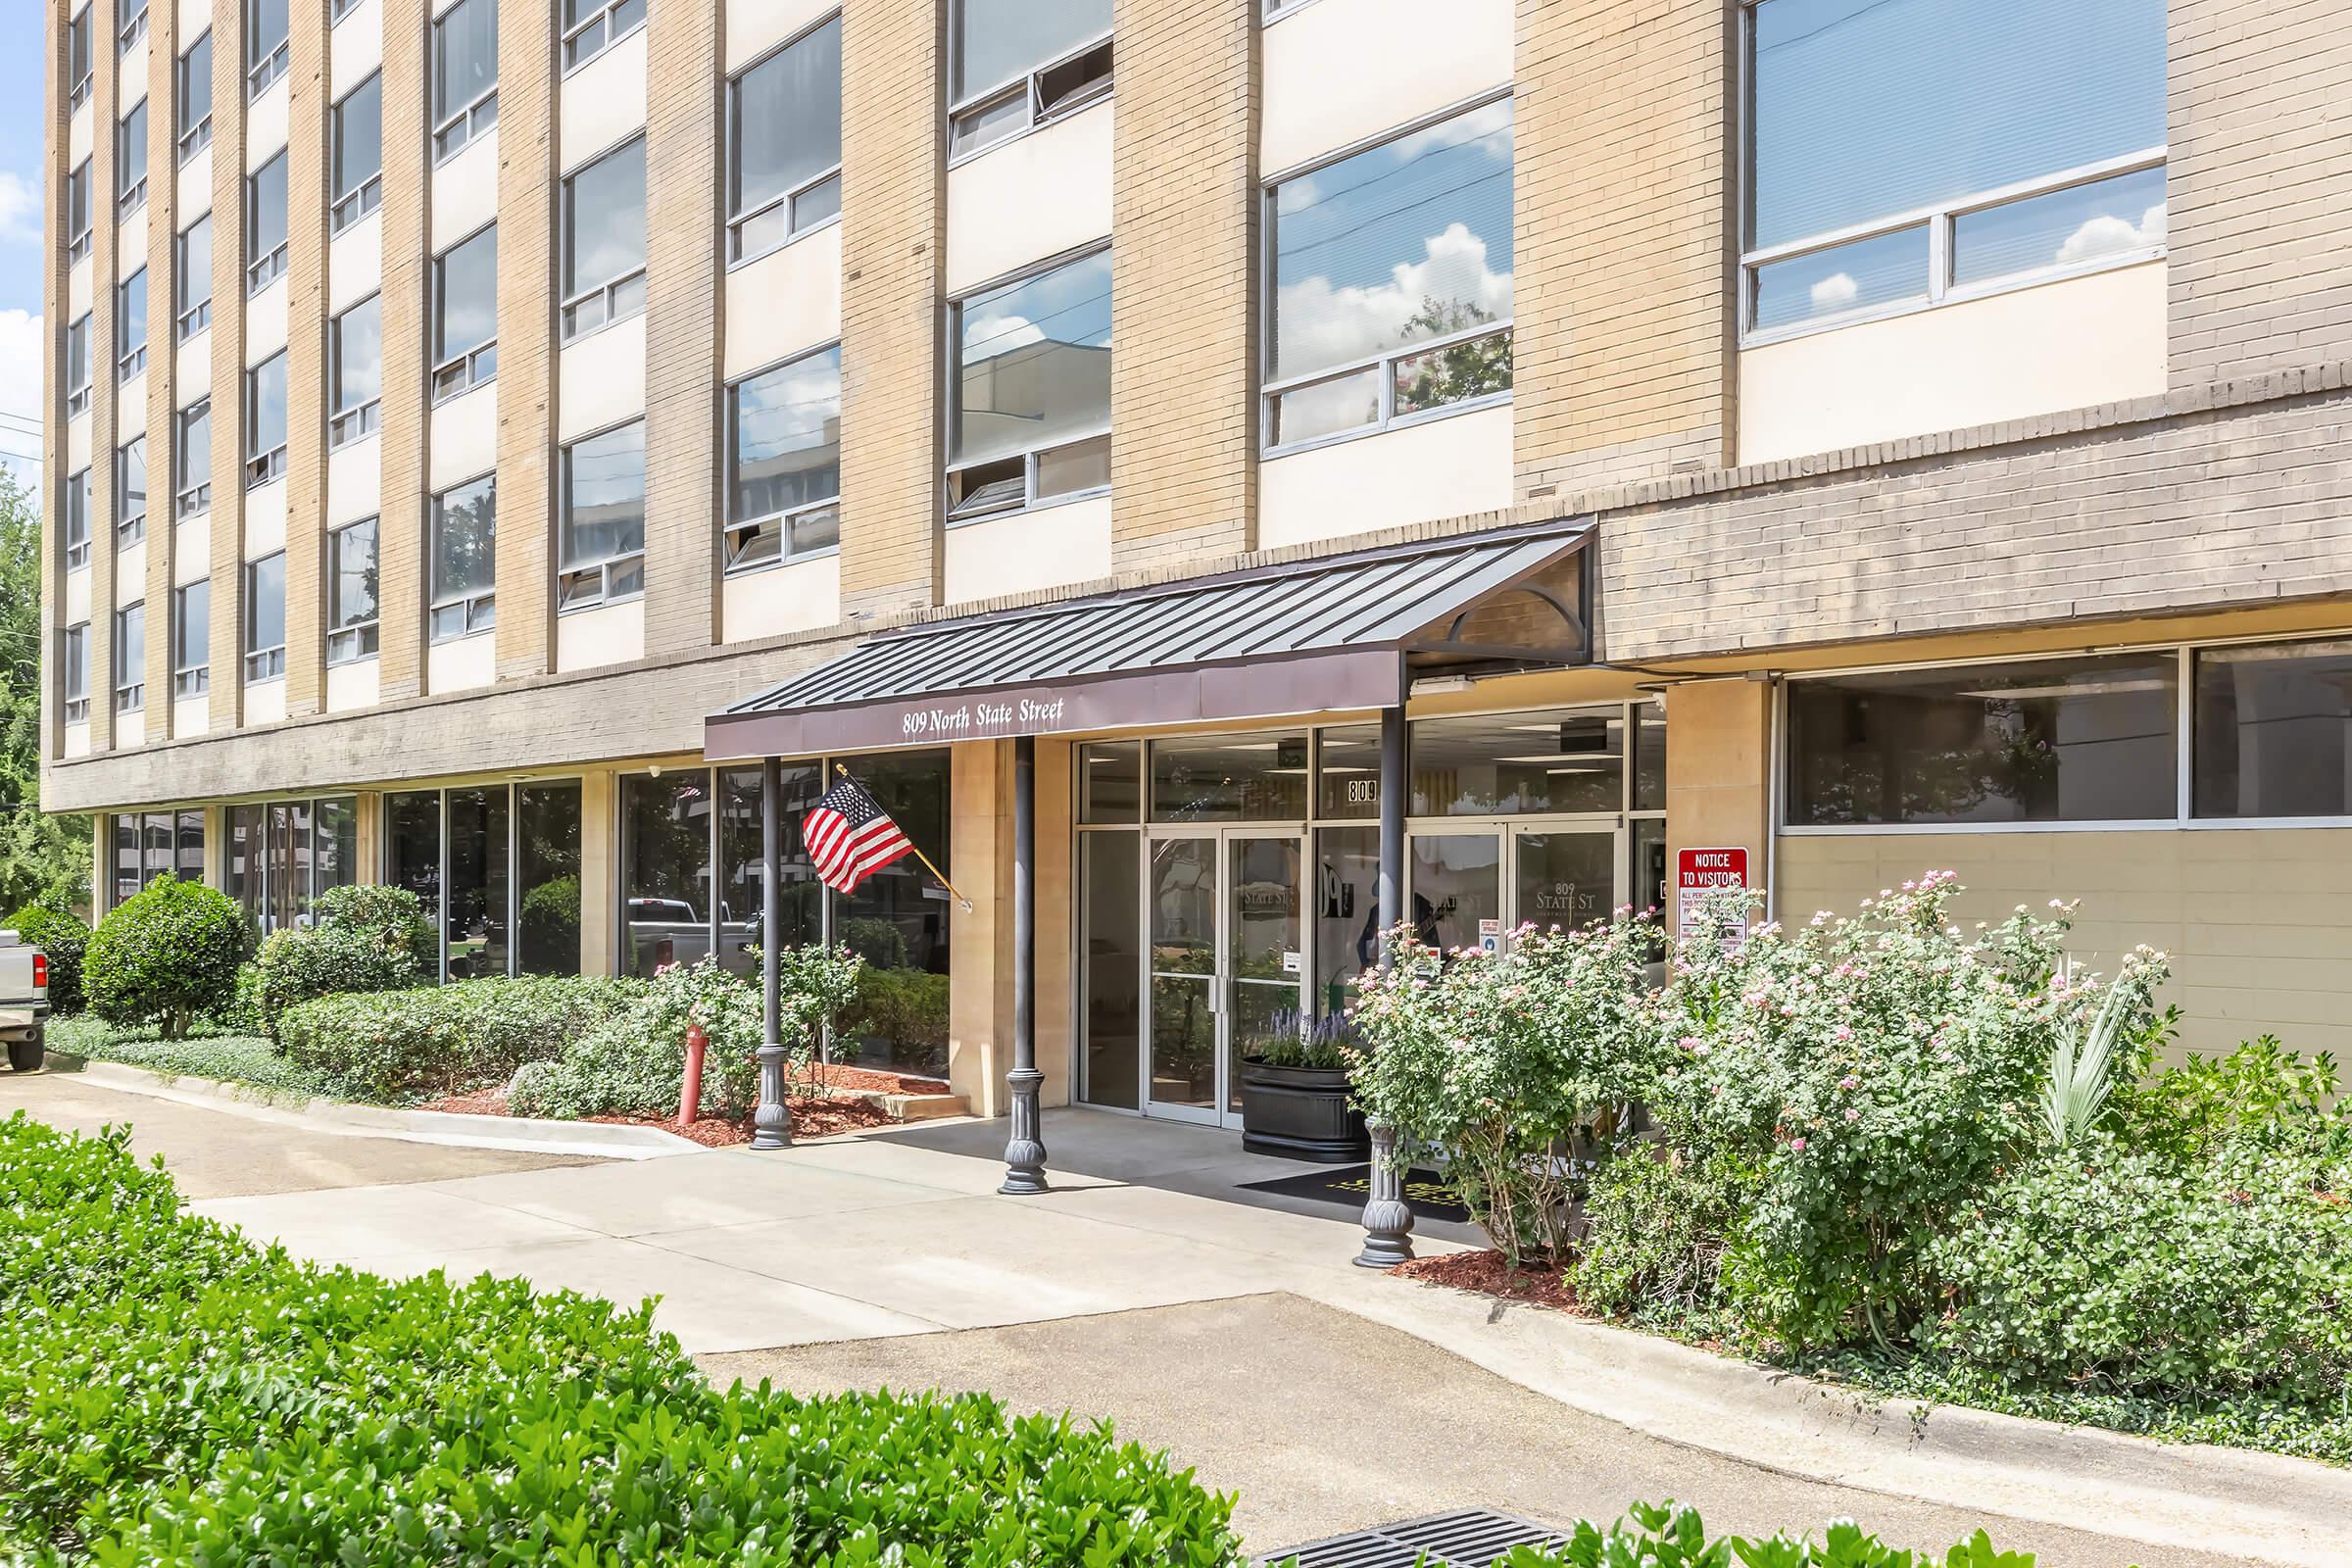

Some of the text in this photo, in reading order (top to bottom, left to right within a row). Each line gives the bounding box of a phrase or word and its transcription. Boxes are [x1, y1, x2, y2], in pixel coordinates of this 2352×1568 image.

[903, 698, 1064, 734] 809 North State Street
[1349, 781, 1376, 801] 809
[1694, 854, 1731, 867] NOTICE
[1683, 871, 1742, 886] TO VISITORS
[1555, 883, 1575, 895] 809
[1245, 893, 1274, 904] STATE
[1536, 892, 1596, 909] STATE ST
